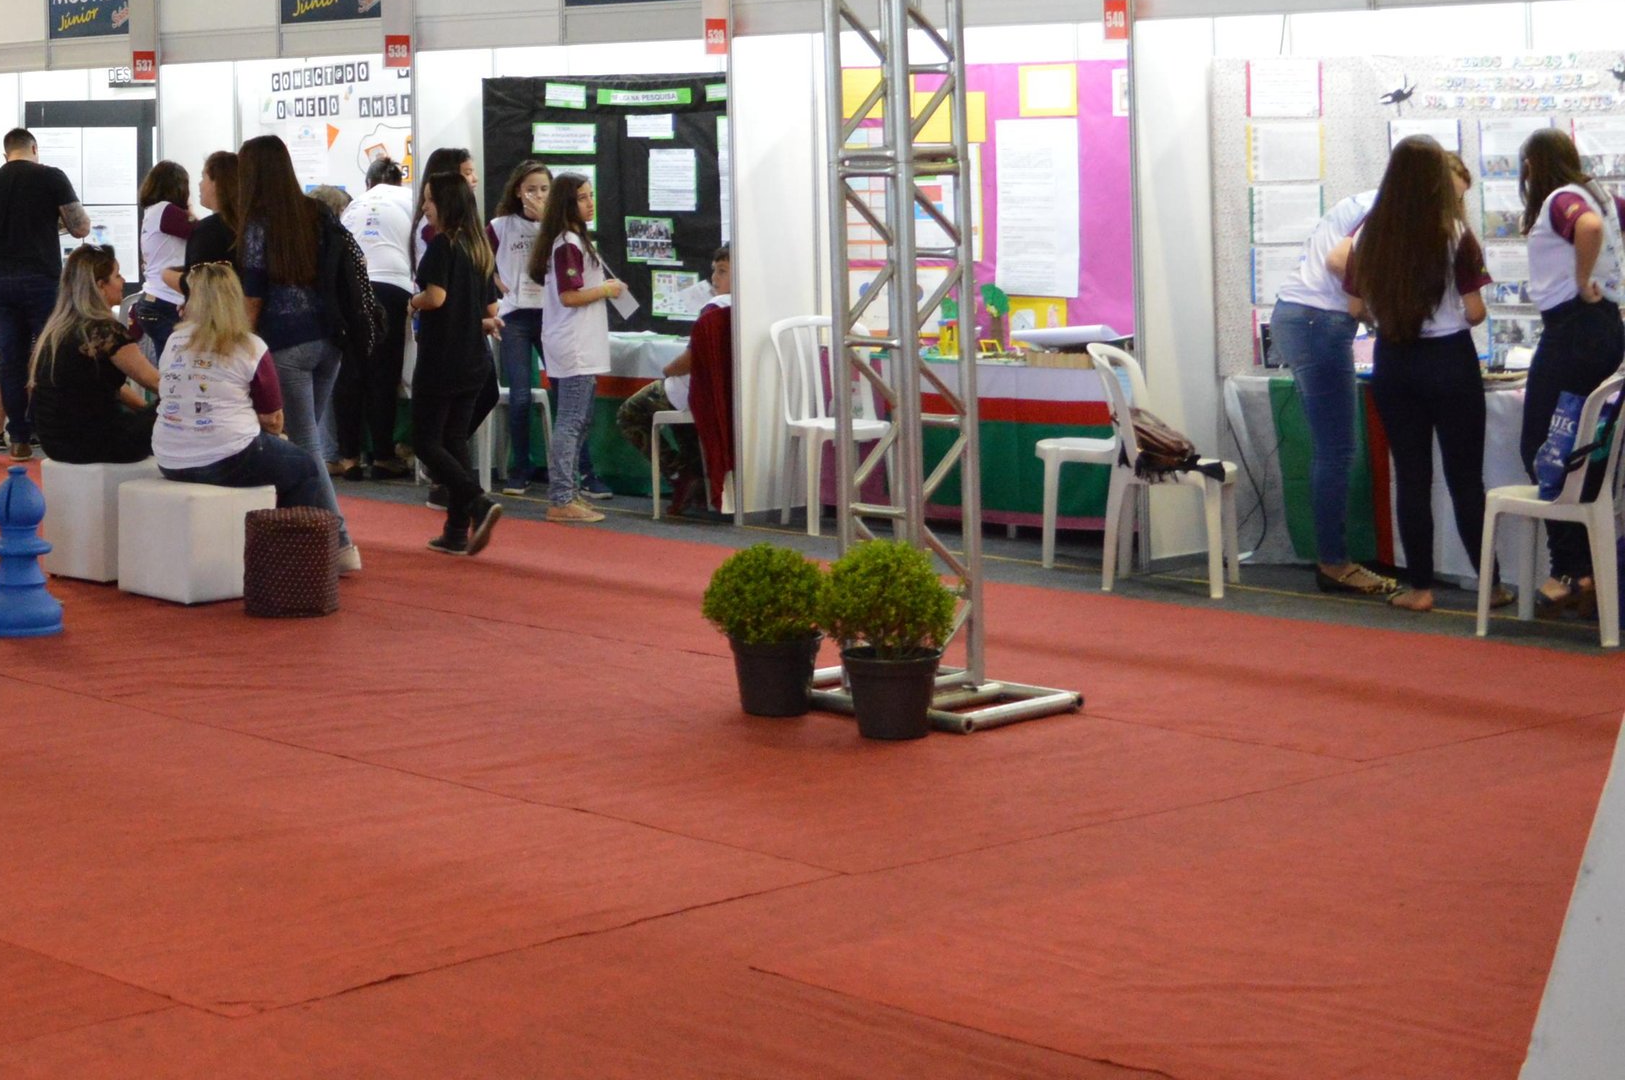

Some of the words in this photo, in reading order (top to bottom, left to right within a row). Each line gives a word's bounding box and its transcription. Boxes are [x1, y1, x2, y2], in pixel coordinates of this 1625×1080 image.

[58, 6, 99, 32] Júnior
[388, 44, 408, 58] 538
[108, 66, 131, 83] DES
[136, 59, 153, 72] 537
[272, 61, 369, 92] CONECT@DO
[294, 95, 340, 118] MEIO
[358, 94, 411, 118] AMBI
